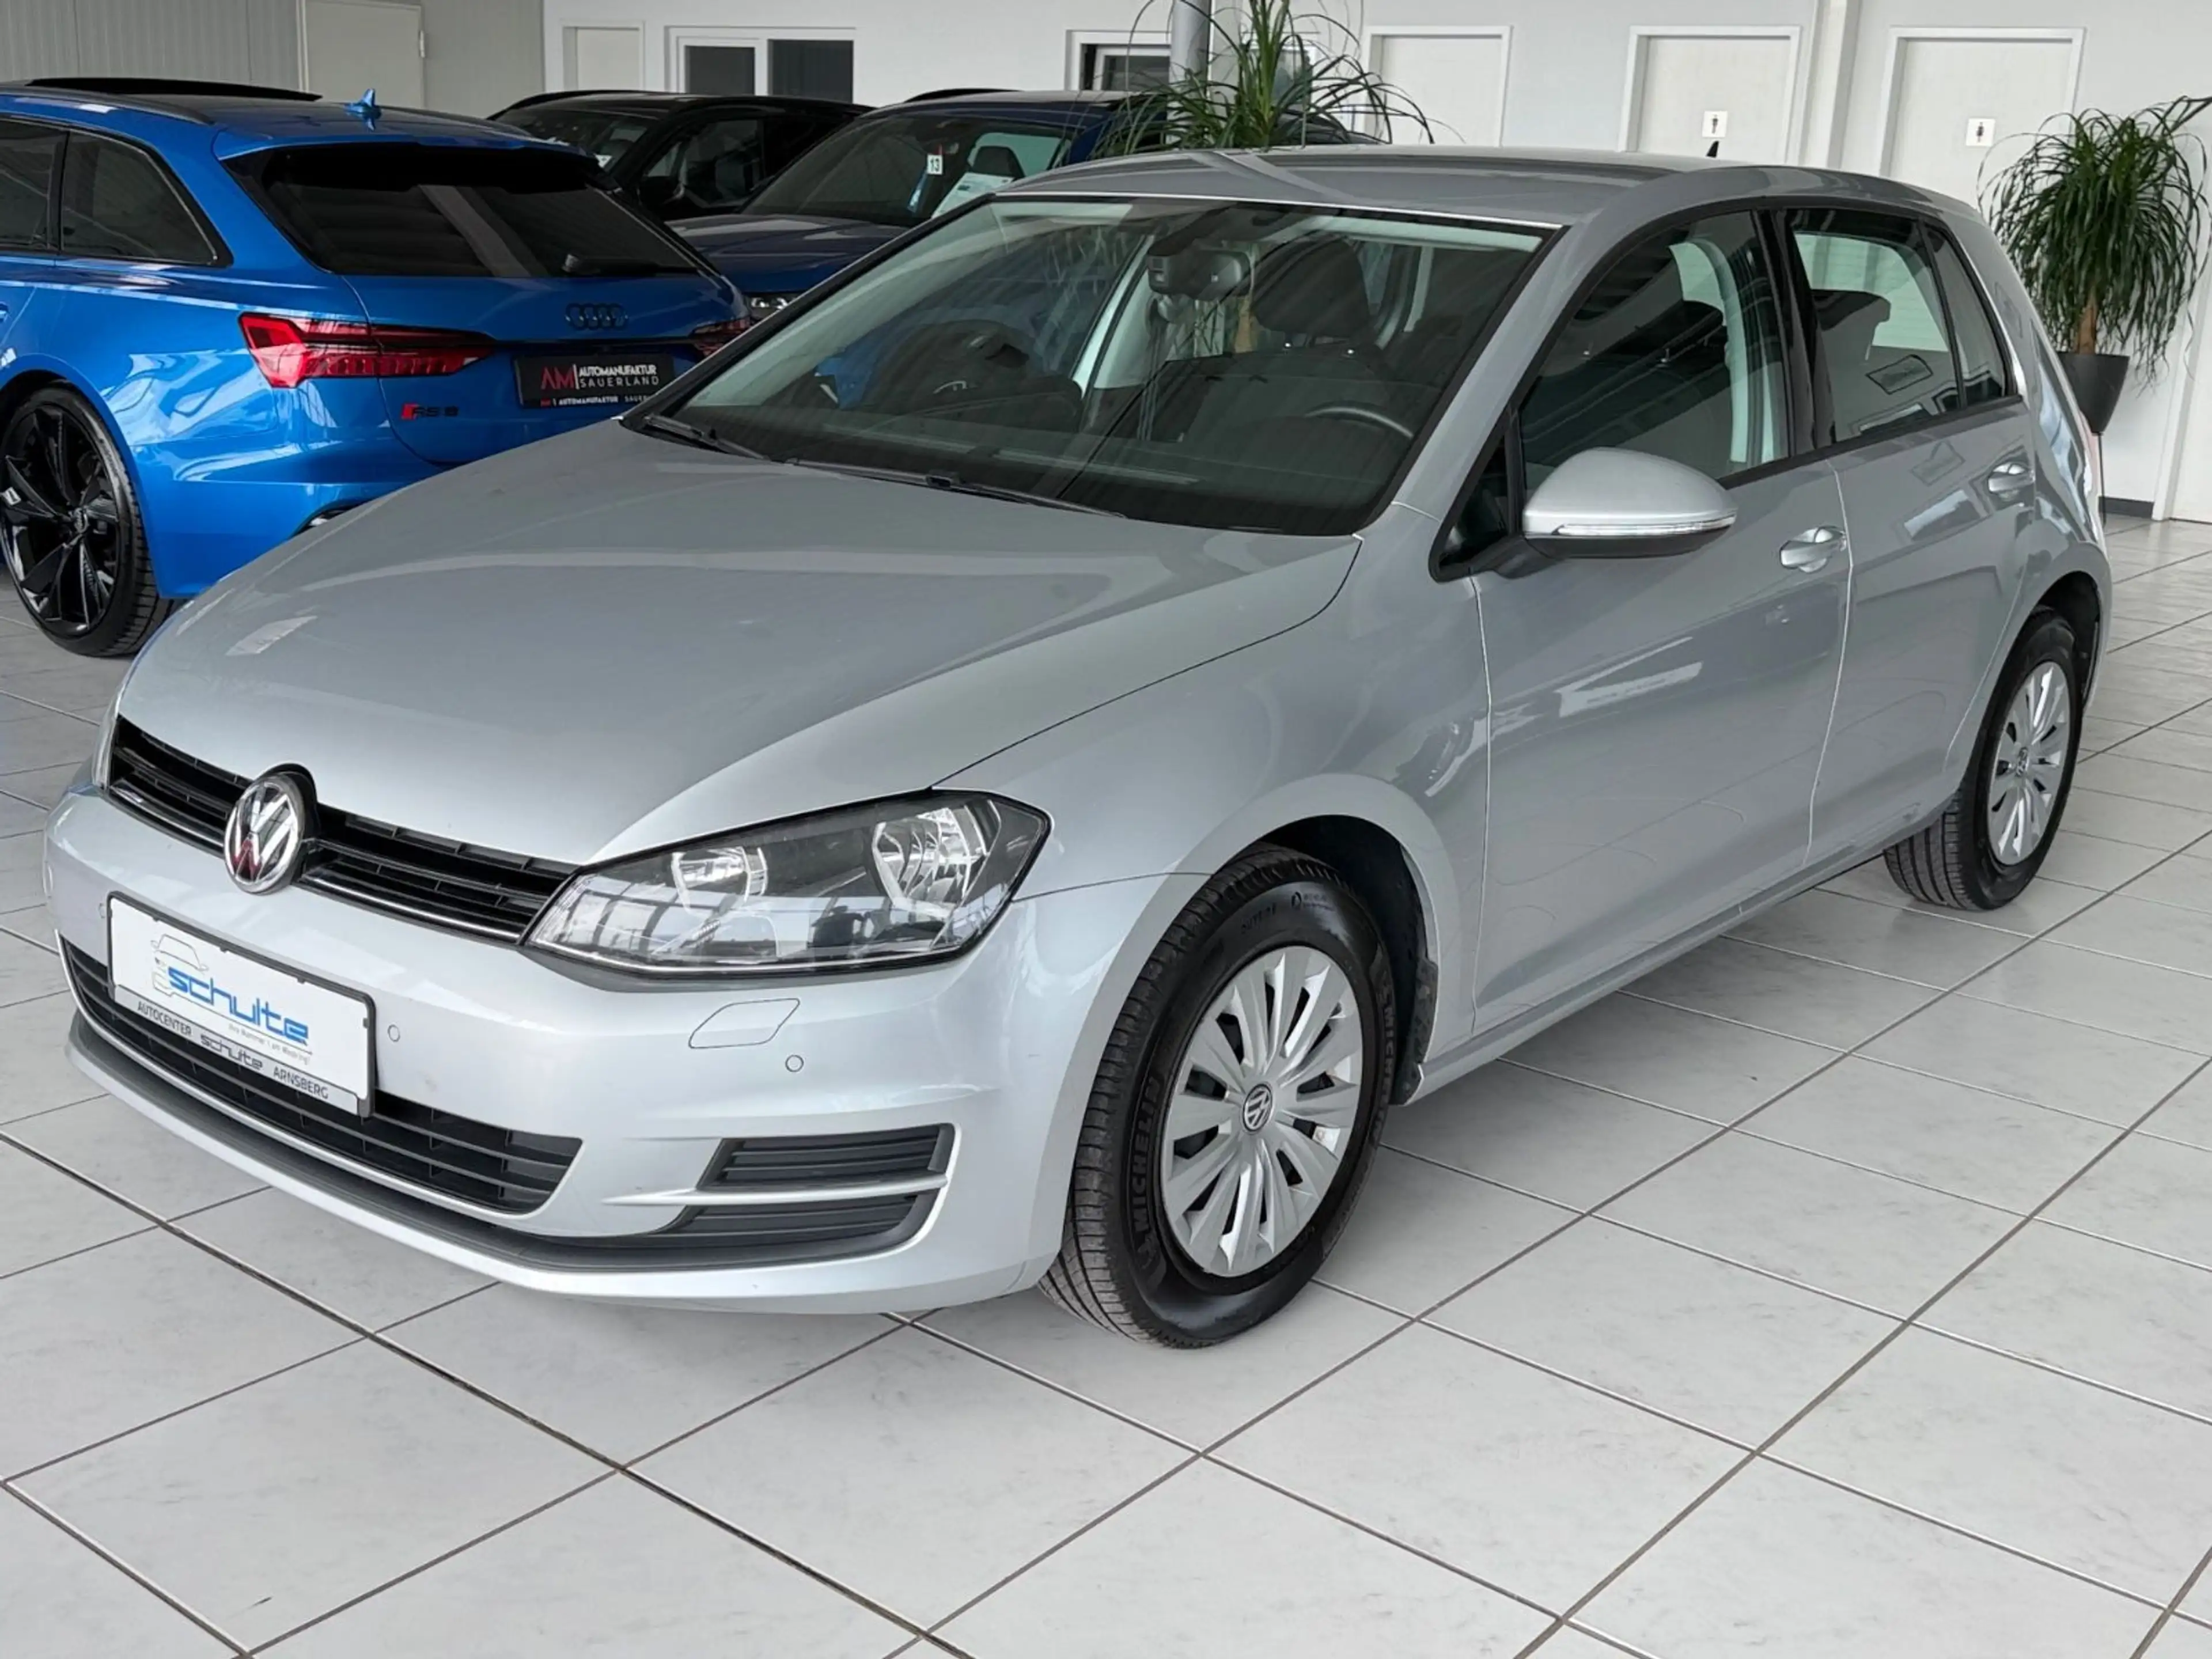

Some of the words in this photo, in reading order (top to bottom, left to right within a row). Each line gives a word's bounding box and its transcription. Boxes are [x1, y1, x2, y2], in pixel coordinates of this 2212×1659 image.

[929, 157, 940, 172] 13
[578, 365, 657, 377] AUTOMANUFAKTUR
[580, 377, 659, 388] SAUERLAND
[137, 1001, 192, 1036] AUTOCENTER
[274, 1066, 329, 1099] ARNSBERG
